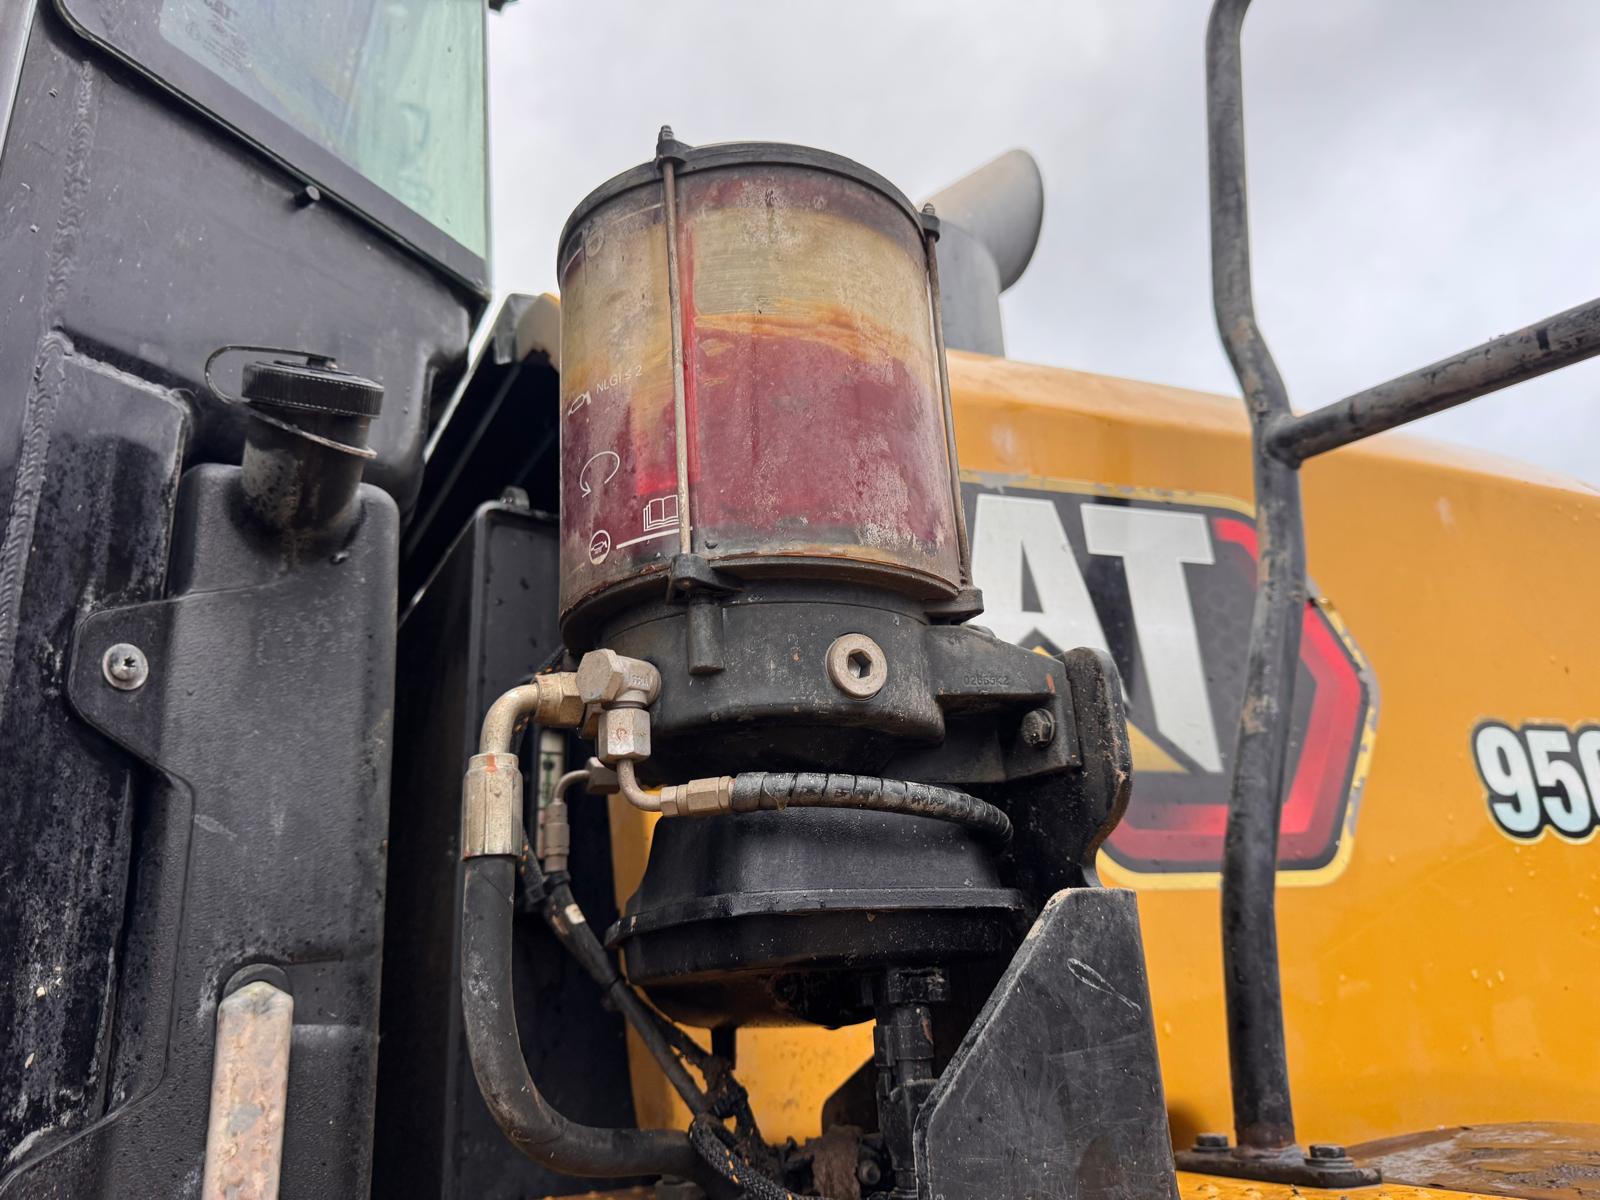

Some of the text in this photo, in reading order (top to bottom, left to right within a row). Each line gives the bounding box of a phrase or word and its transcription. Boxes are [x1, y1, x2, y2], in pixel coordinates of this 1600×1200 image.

[596, 373, 621, 394] NLGI
[635, 364, 643, 376] 2
[970, 494, 1223, 772] AT
